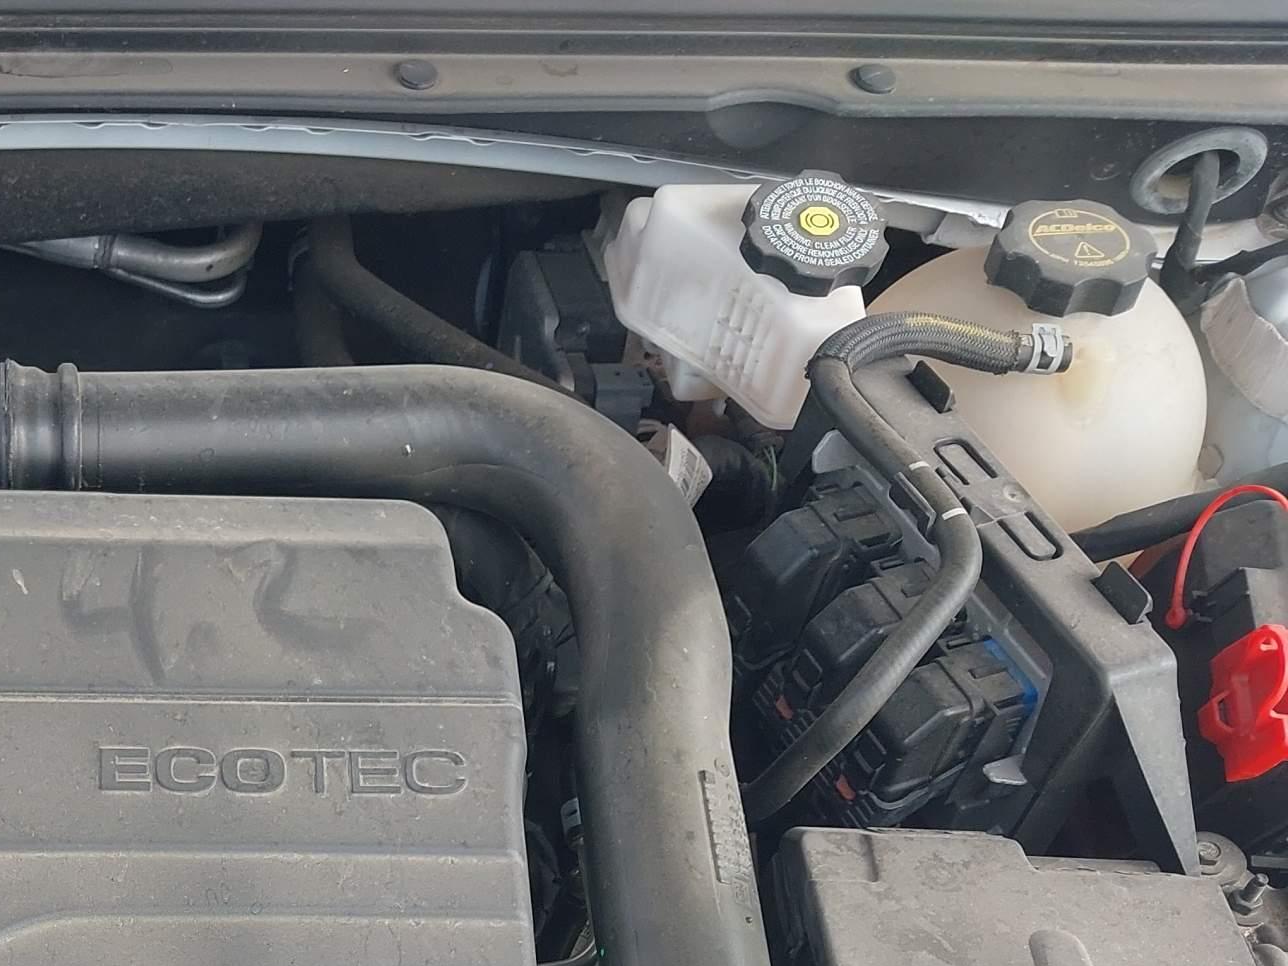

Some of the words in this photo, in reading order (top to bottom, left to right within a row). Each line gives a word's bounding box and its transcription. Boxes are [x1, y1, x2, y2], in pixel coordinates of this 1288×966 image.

[814, 241, 842, 250] CLEAN
[838, 226, 857, 246] FILLER
[1034, 222, 1118, 234] ACDelco
[773, 240, 794, 257] FLUID
[793, 252, 818, 265] FROM
[780, 234, 810, 255] BEFORE
[98, 745, 469, 799] ECOTEC
